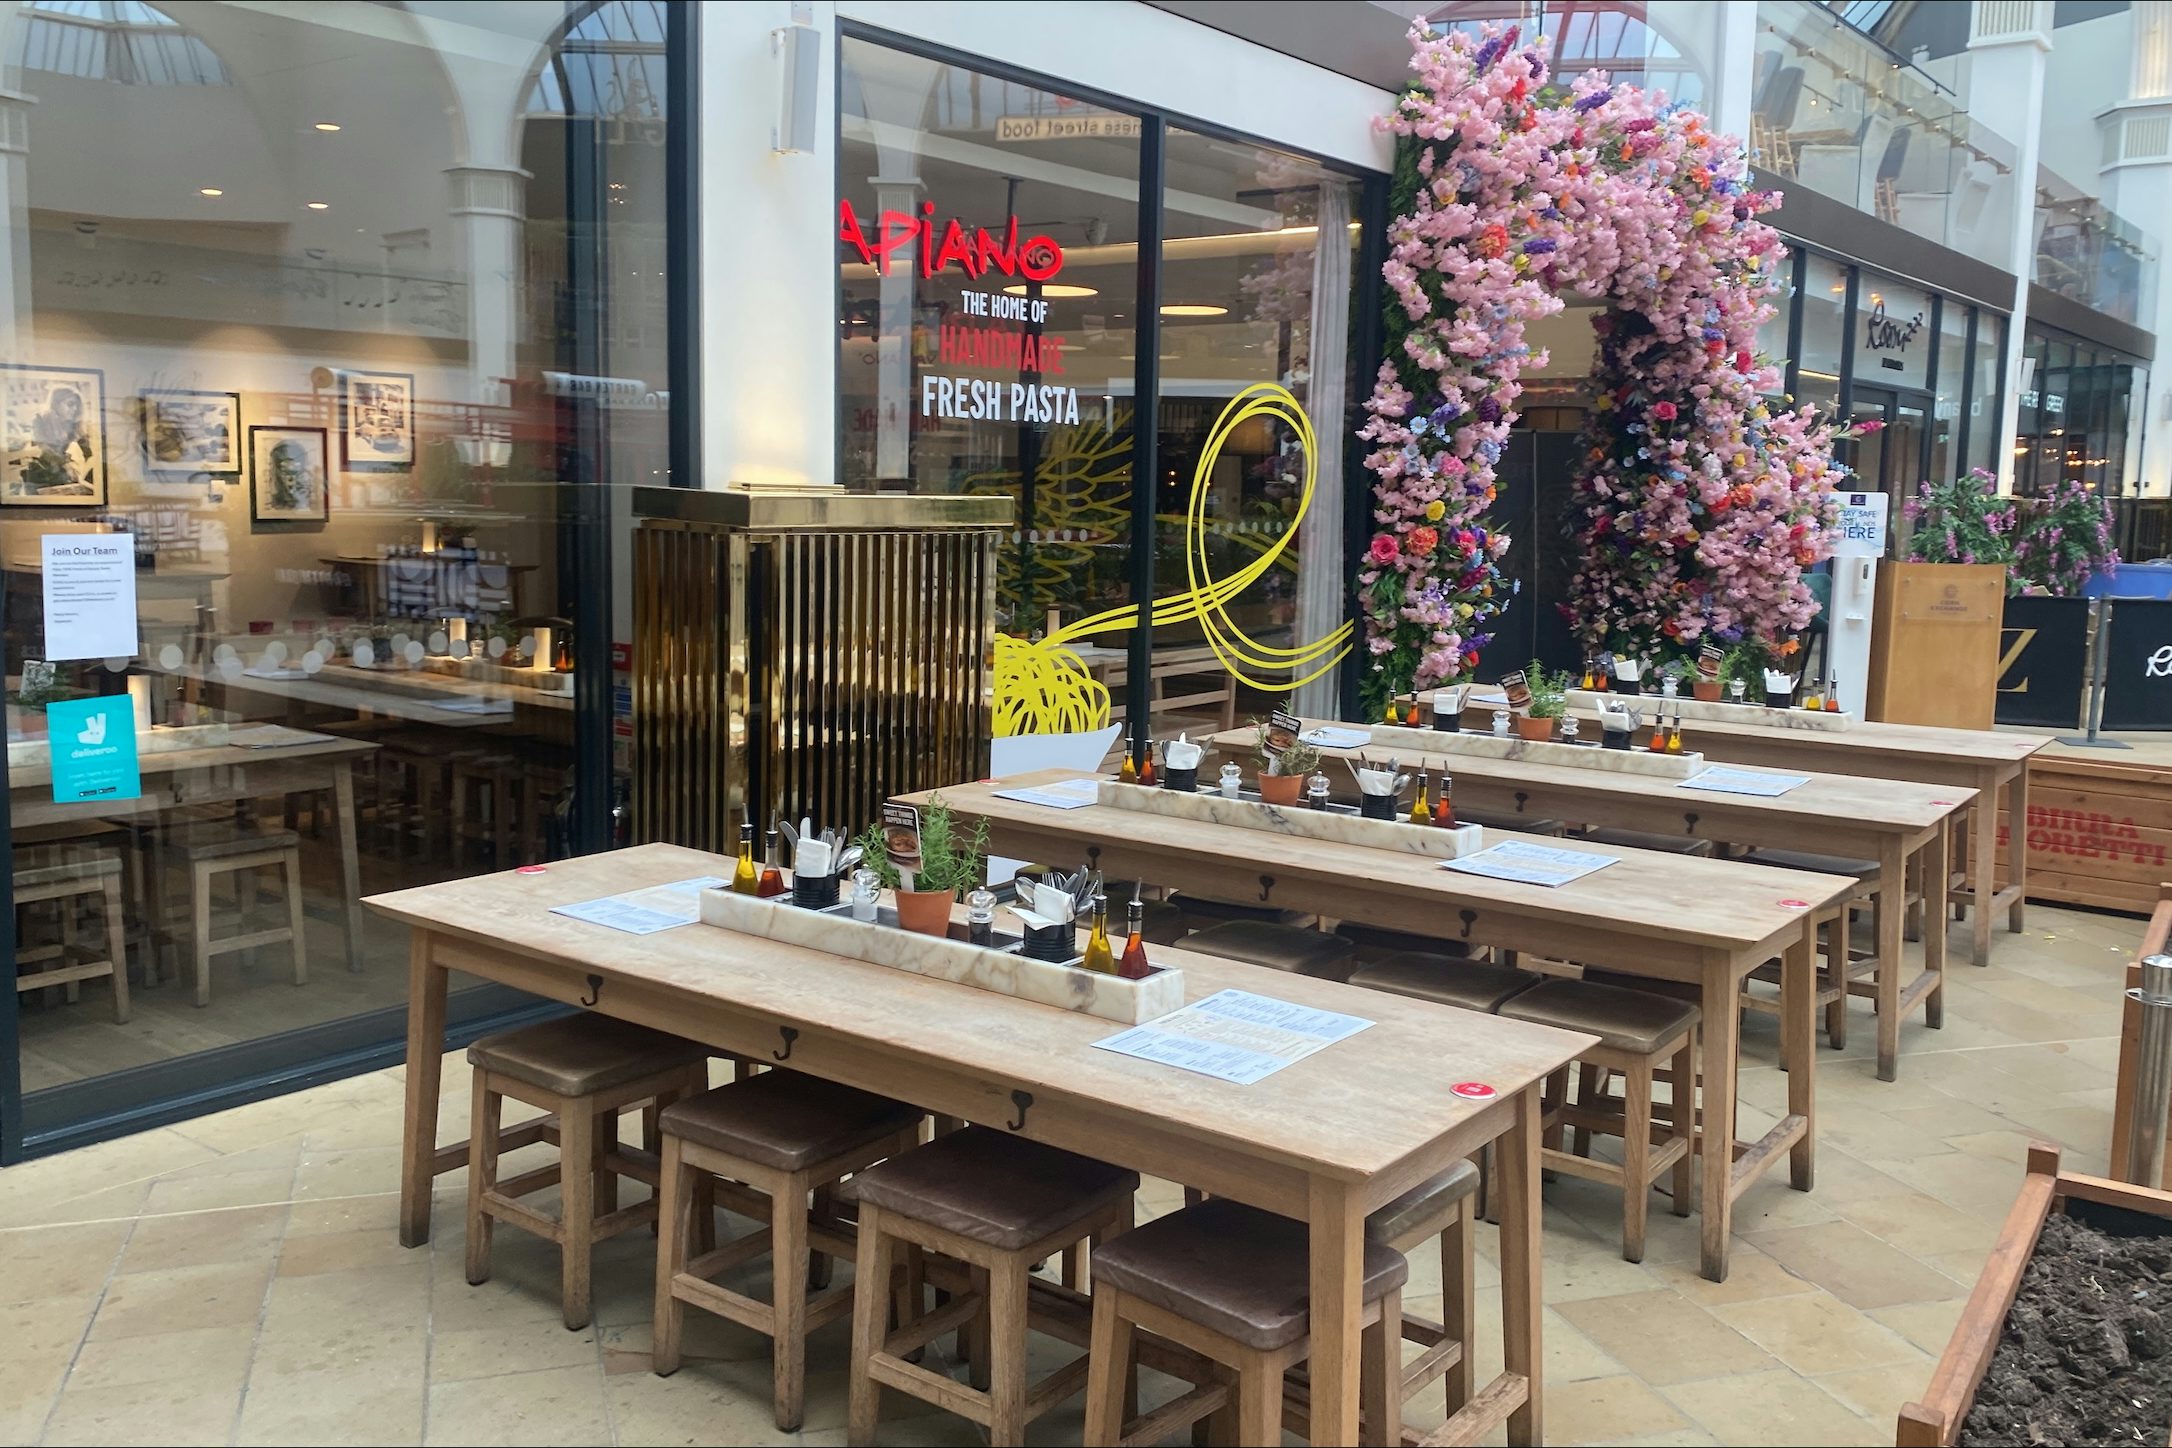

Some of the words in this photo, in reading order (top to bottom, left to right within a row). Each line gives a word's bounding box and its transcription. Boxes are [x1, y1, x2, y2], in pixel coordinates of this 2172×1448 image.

[840, 198, 1063, 281] APiANO
[961, 289, 988, 317] THE
[991, 293, 1028, 322] HOME
[1030, 298, 1048, 324] OF
[940, 324, 1066, 375] HANDMADE
[922, 375, 1001, 420] FRESH
[1010, 382, 1080, 426] PASTA
[1858, 510, 1877, 518] SAFE
[52, 547, 71, 556] Join
[73, 547, 91, 556] Our
[93, 546, 118, 556] Team
[71, 746, 118, 759] deliveroo
[2026, 804, 2139, 839] BIRRA
